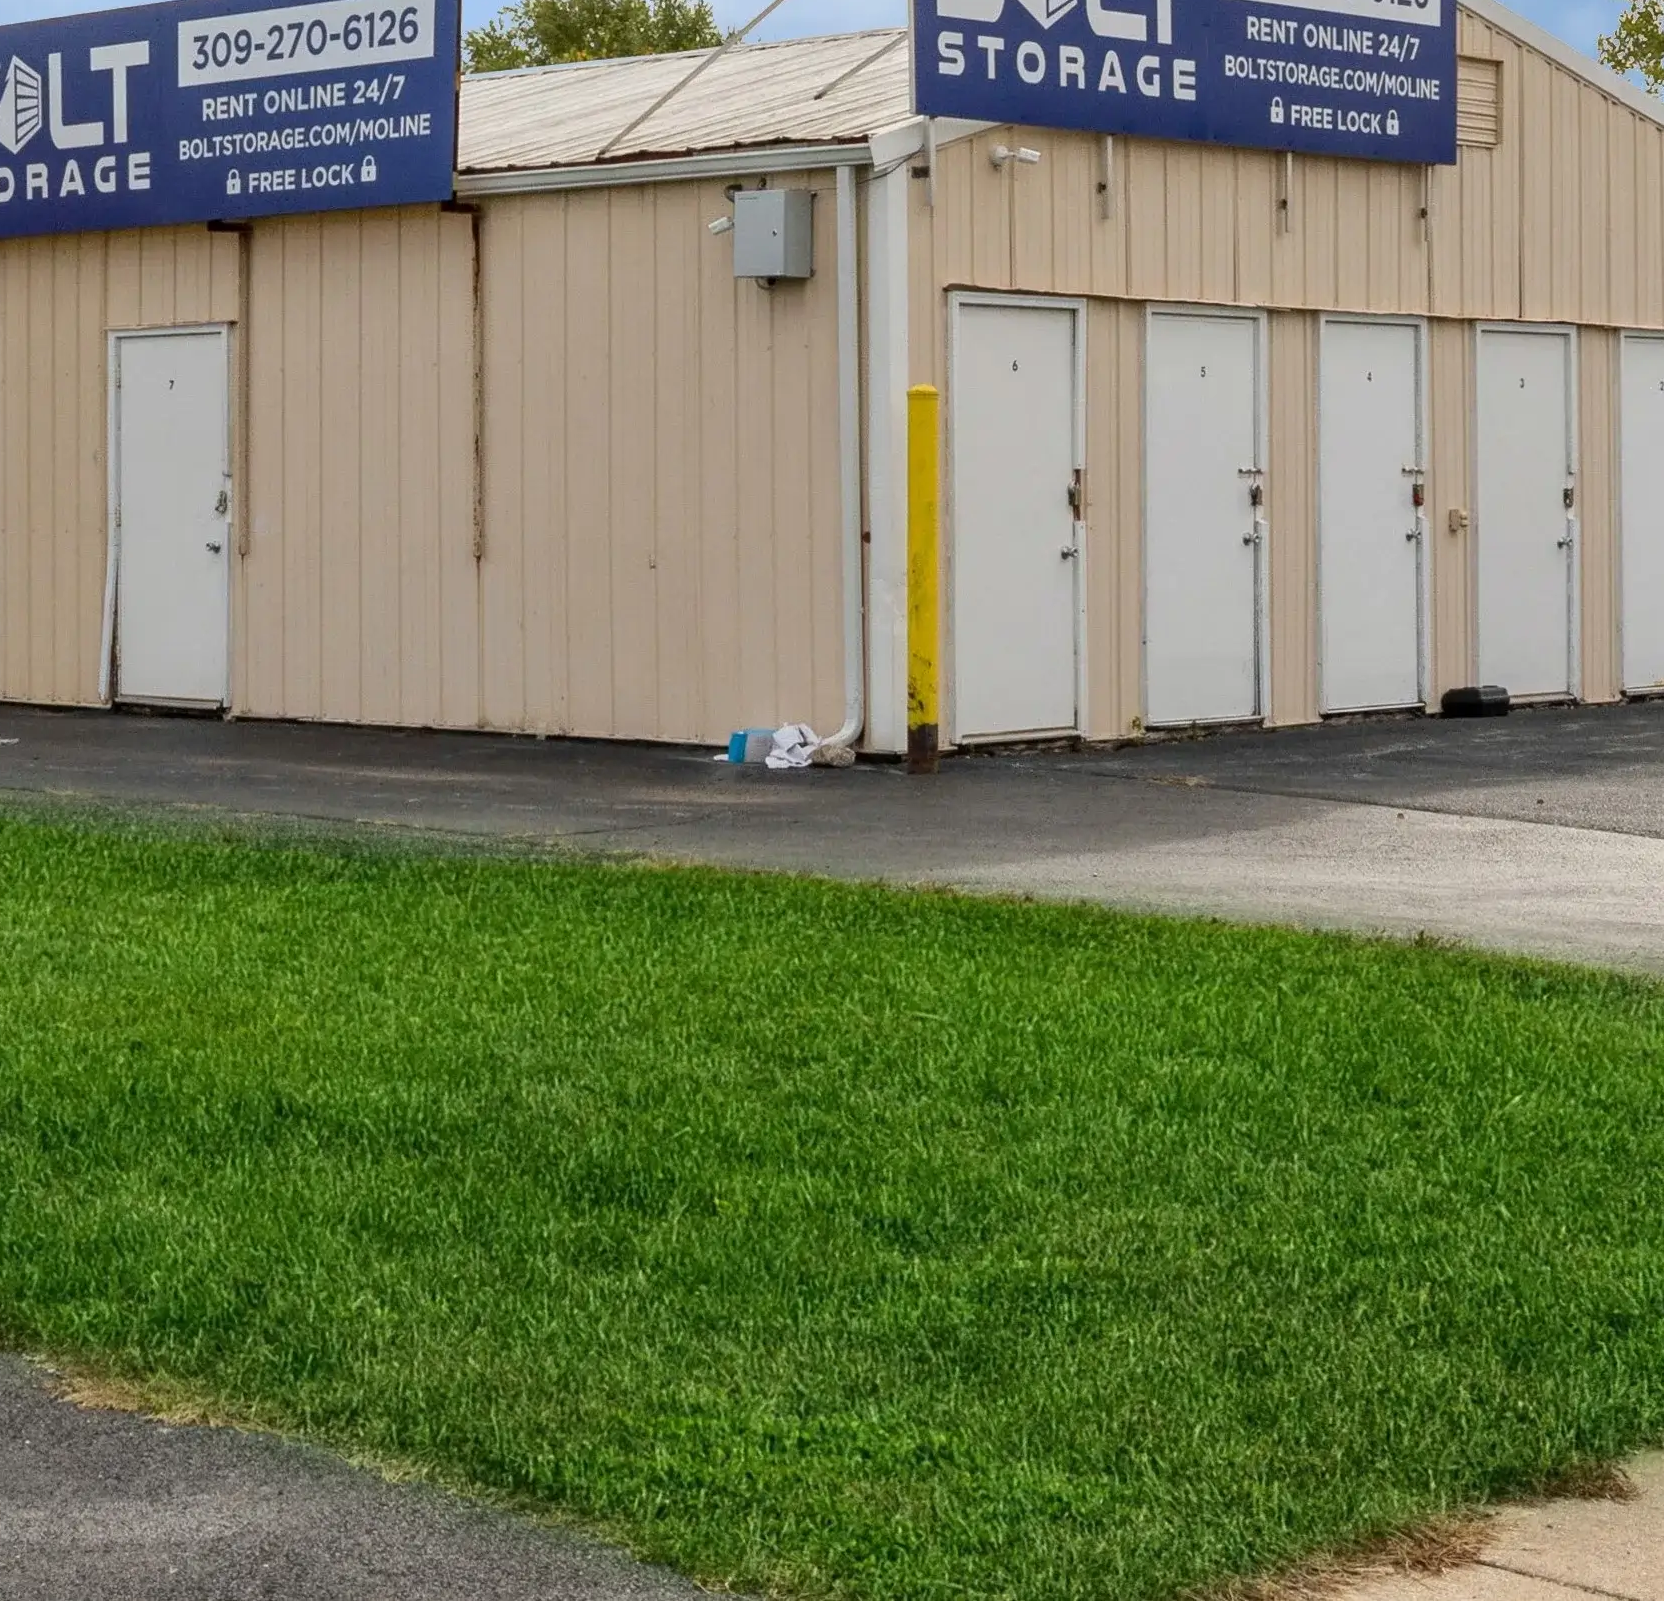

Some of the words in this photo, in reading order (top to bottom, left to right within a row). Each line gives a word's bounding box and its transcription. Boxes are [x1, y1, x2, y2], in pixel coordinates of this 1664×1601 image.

[192, 6, 419, 70] 309-270-6126
[1246, 16, 1297, 48] RENT
[1303, 25, 1373, 55] ONLINE
[1378, 33, 1420, 62] 24/7
[937, 31, 1197, 101] STORAGE
[1224, 54, 1440, 101] BOLTSTORAGE.COM/MOLINE
[202, 94, 256, 122] RENT
[263, 82, 345, 114] ONLINE
[352, 74, 405, 106] 24/7
[1290, 105, 1333, 131] FREE
[1337, 110, 1382, 135] LOCK
[178, 113, 431, 161] BOLTSTORAGE.COM/MOLINE
[248, 171, 295, 194] FREE
[301, 164, 354, 188] LOCK
[1012, 360, 1018, 371] 6
[1200, 366, 1206, 378] 5
[1367, 371, 1372, 382] 4
[169, 379, 175, 390] 7
[1520, 377, 1525, 388] 3
[1659, 381, 1664, 391] 2
